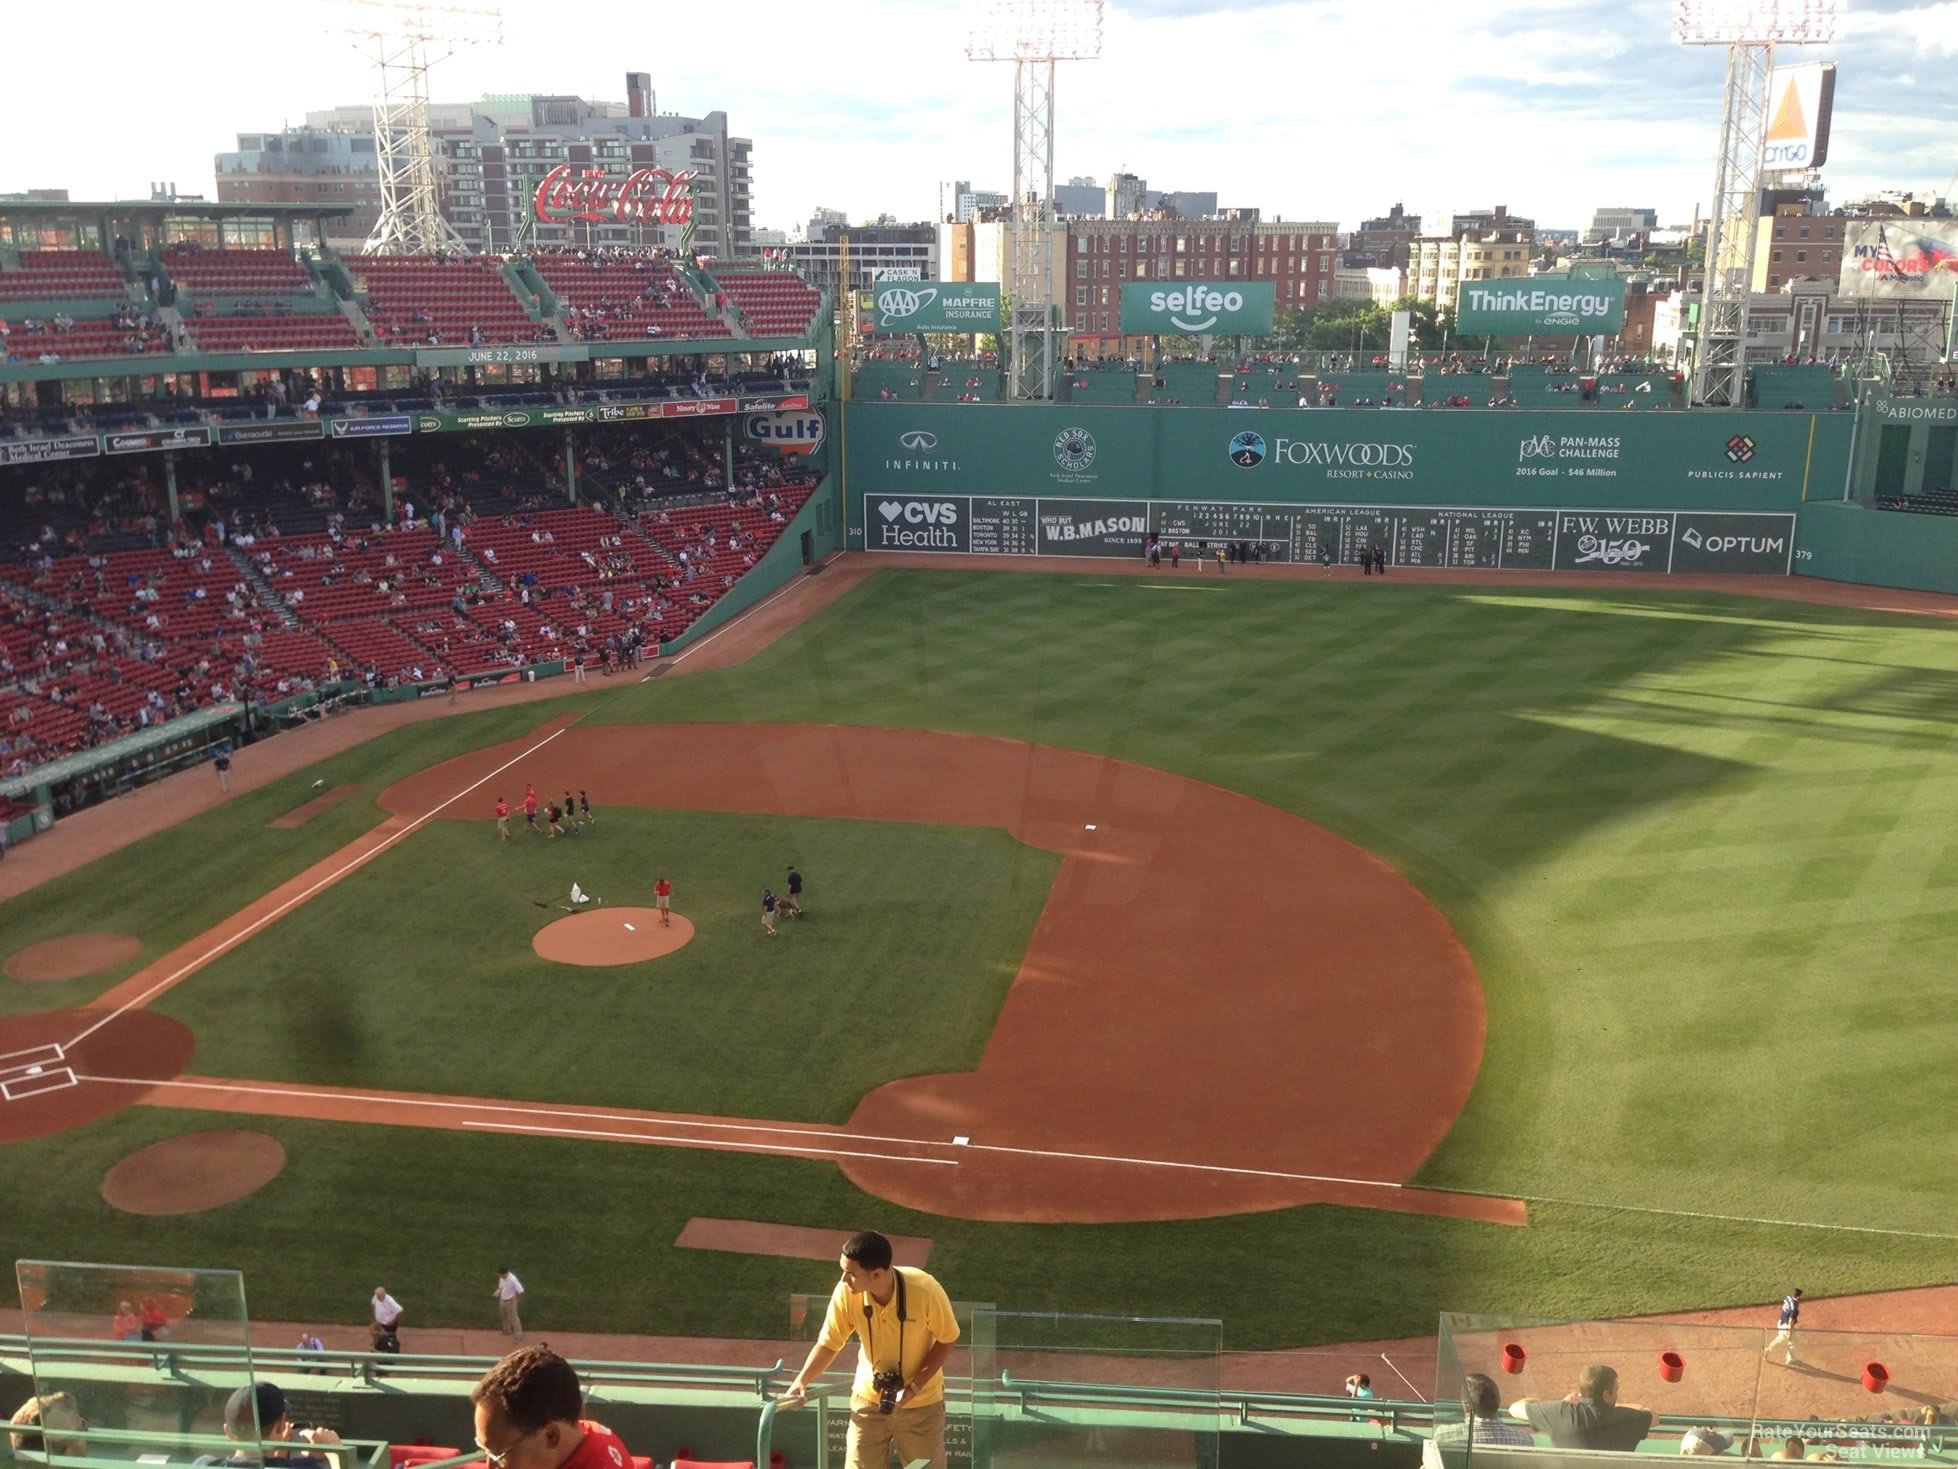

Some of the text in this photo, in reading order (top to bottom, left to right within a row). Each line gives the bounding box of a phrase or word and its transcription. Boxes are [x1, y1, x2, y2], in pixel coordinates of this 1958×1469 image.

[534, 164, 698, 224] Coca-Cola
[1855, 245, 1877, 257] MY
[883, 290, 916, 316] AAA
[943, 298, 995, 307] MAPFRE
[1469, 290, 1609, 316] ThinkEnergy
[468, 350, 537, 362] JUNE 22, 2016
[600, 407, 624, 419] Tribe
[1888, 407, 1957, 419] ABIOMED
[750, 416, 820, 439] Gulf
[1056, 430, 1089, 448] RED SOX
[1560, 437, 1620, 447] PAN-MASS
[1057, 446, 1094, 469] SCHOLARS
[1559, 449, 1619, 458] CHALLENGE
[886, 460, 956, 471] INFINITI
[1327, 470, 1413, 479] RESORT CASINO
[1515, 467, 1537, 476] 2016
[1539, 467, 1558, 476] Goal
[1568, 468, 1584, 476] $46
[1586, 468, 1617, 477] Million
[904, 502, 957, 524] CVS
[1562, 517, 1669, 535] F.W. WEBB
[881, 525, 958, 547] Health
[1706, 537, 1784, 553] OPTUM
[1795, 550, 1812, 560] 379
